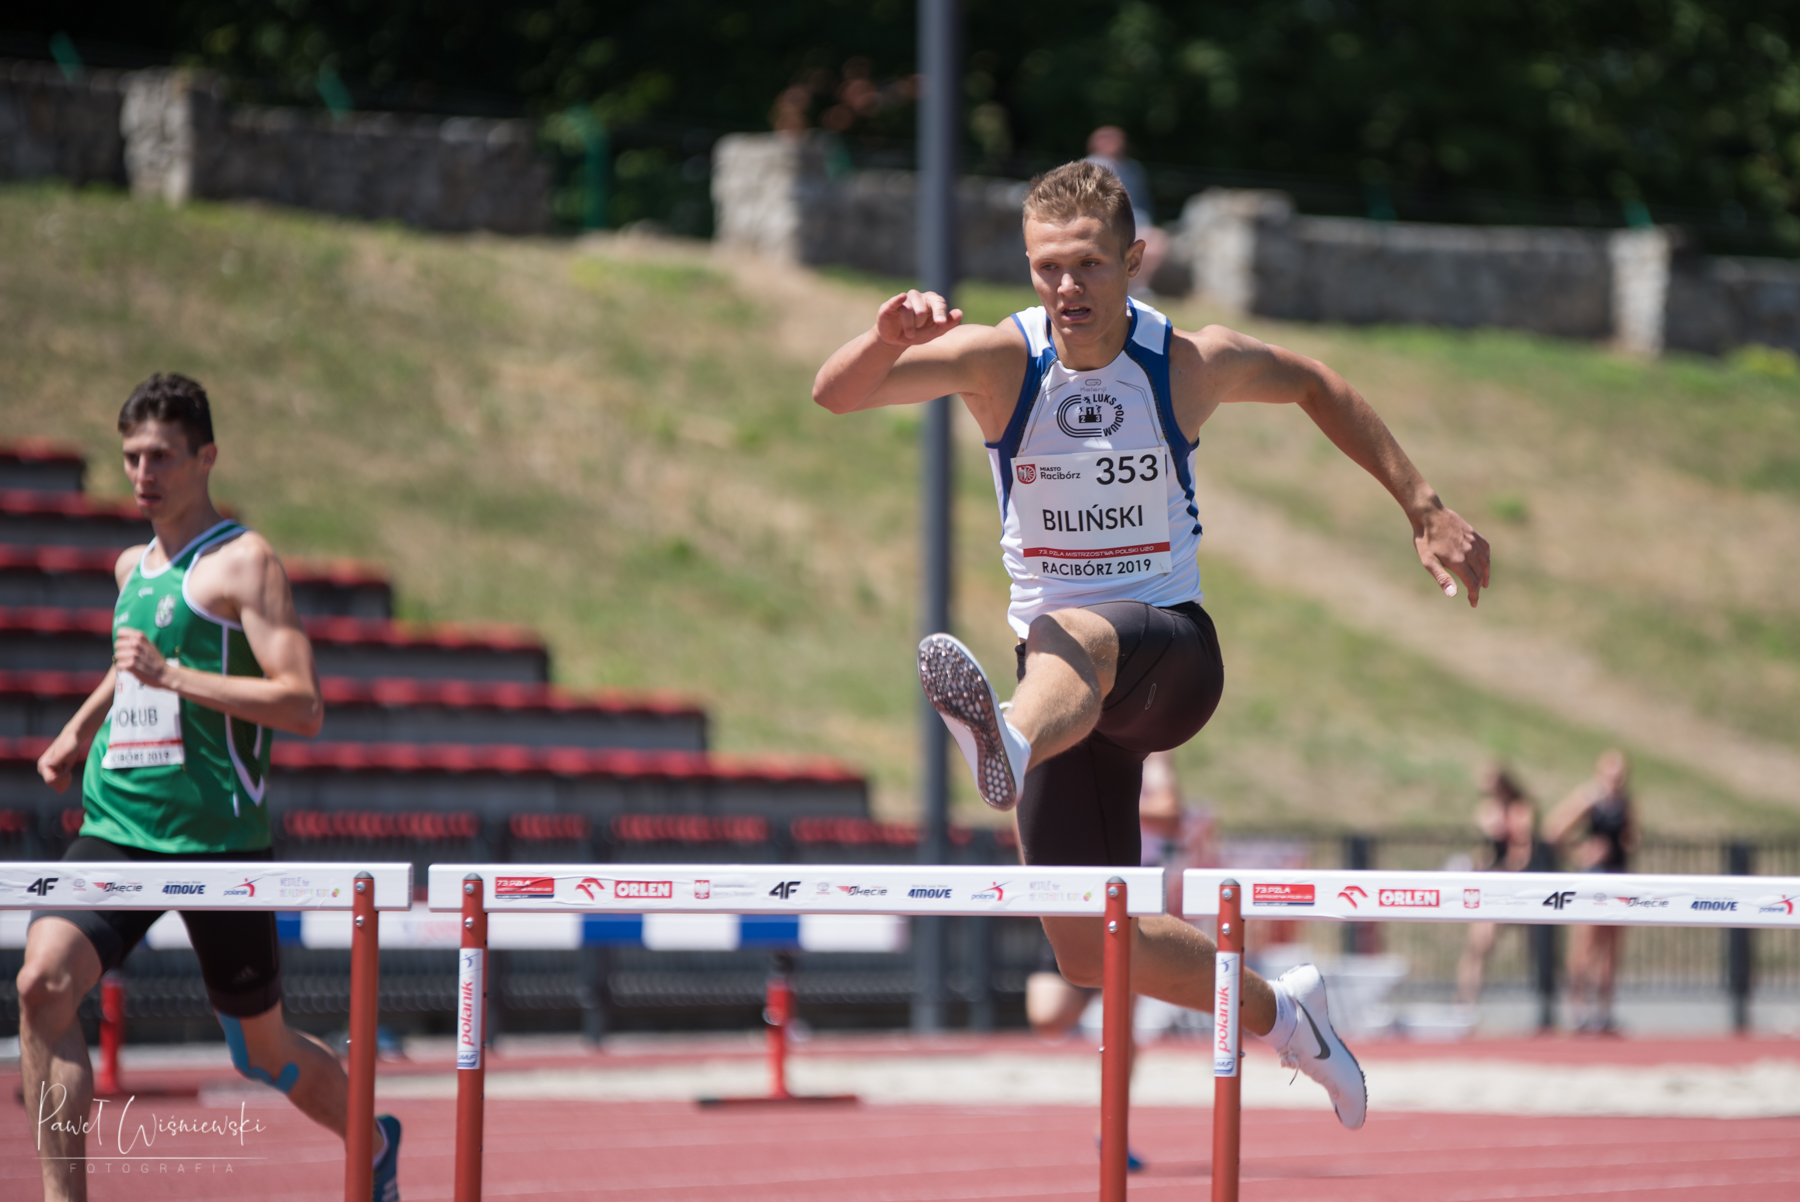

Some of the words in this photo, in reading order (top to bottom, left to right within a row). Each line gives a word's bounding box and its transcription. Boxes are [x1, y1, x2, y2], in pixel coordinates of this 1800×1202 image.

[1093, 394, 1117, 406] LUKS
[1102, 404, 1124, 437] PODIUM
[1040, 471, 1081, 480] Racibórz
[1095, 454, 1158, 485] 353
[1042, 504, 1143, 532] BILIŃSKI
[1115, 547, 1139, 555] POLSKI
[1042, 560, 1113, 576] RACIBÓRZ
[1117, 558, 1151, 574] 2019
[27, 878, 59, 896] 4F
[162, 884, 206, 895] 4MOVE
[616, 882, 670, 898] ORLEN
[769, 881, 801, 900] 4F
[908, 888, 953, 899] 4MOVE
[1380, 891, 1438, 906] ORLEN
[1542, 891, 1576, 910] 4F
[1690, 900, 1739, 912] 4MOVE
[460, 980, 475, 1047] polanik
[1216, 985, 1232, 1054] polanik
